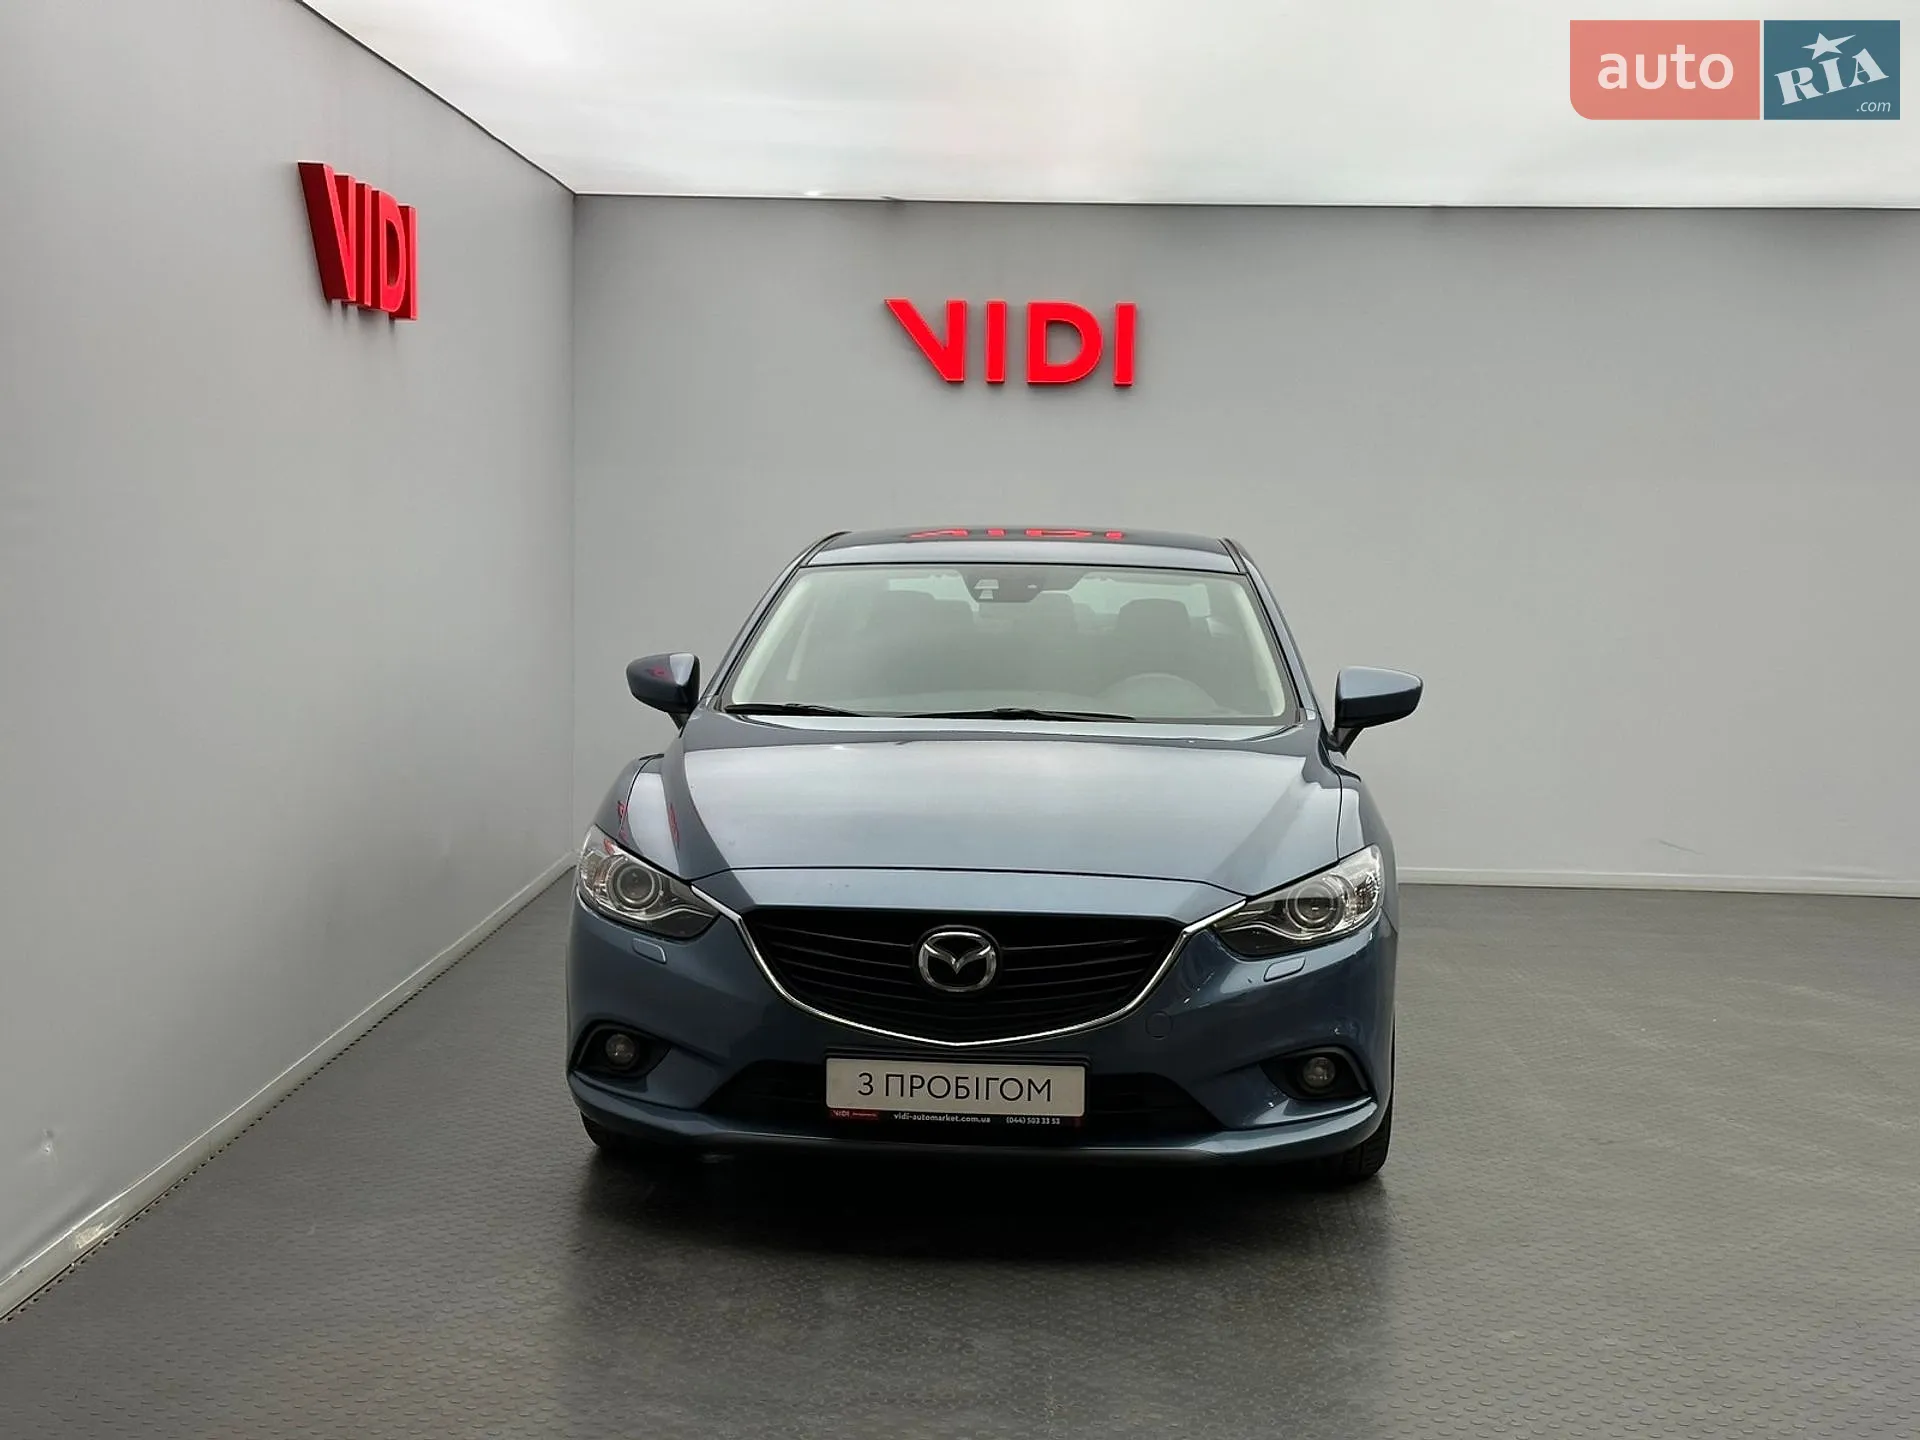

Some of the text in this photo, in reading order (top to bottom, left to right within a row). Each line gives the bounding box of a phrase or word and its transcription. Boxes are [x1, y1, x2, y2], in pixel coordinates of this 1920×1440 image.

[298, 160, 418, 321] VIDI
[884, 298, 1136, 386] VIDI
[885, 1074, 1051, 1102] ПРОБІГОМ
[893, 1112, 991, 1123] vidi-automarket.com.ua
